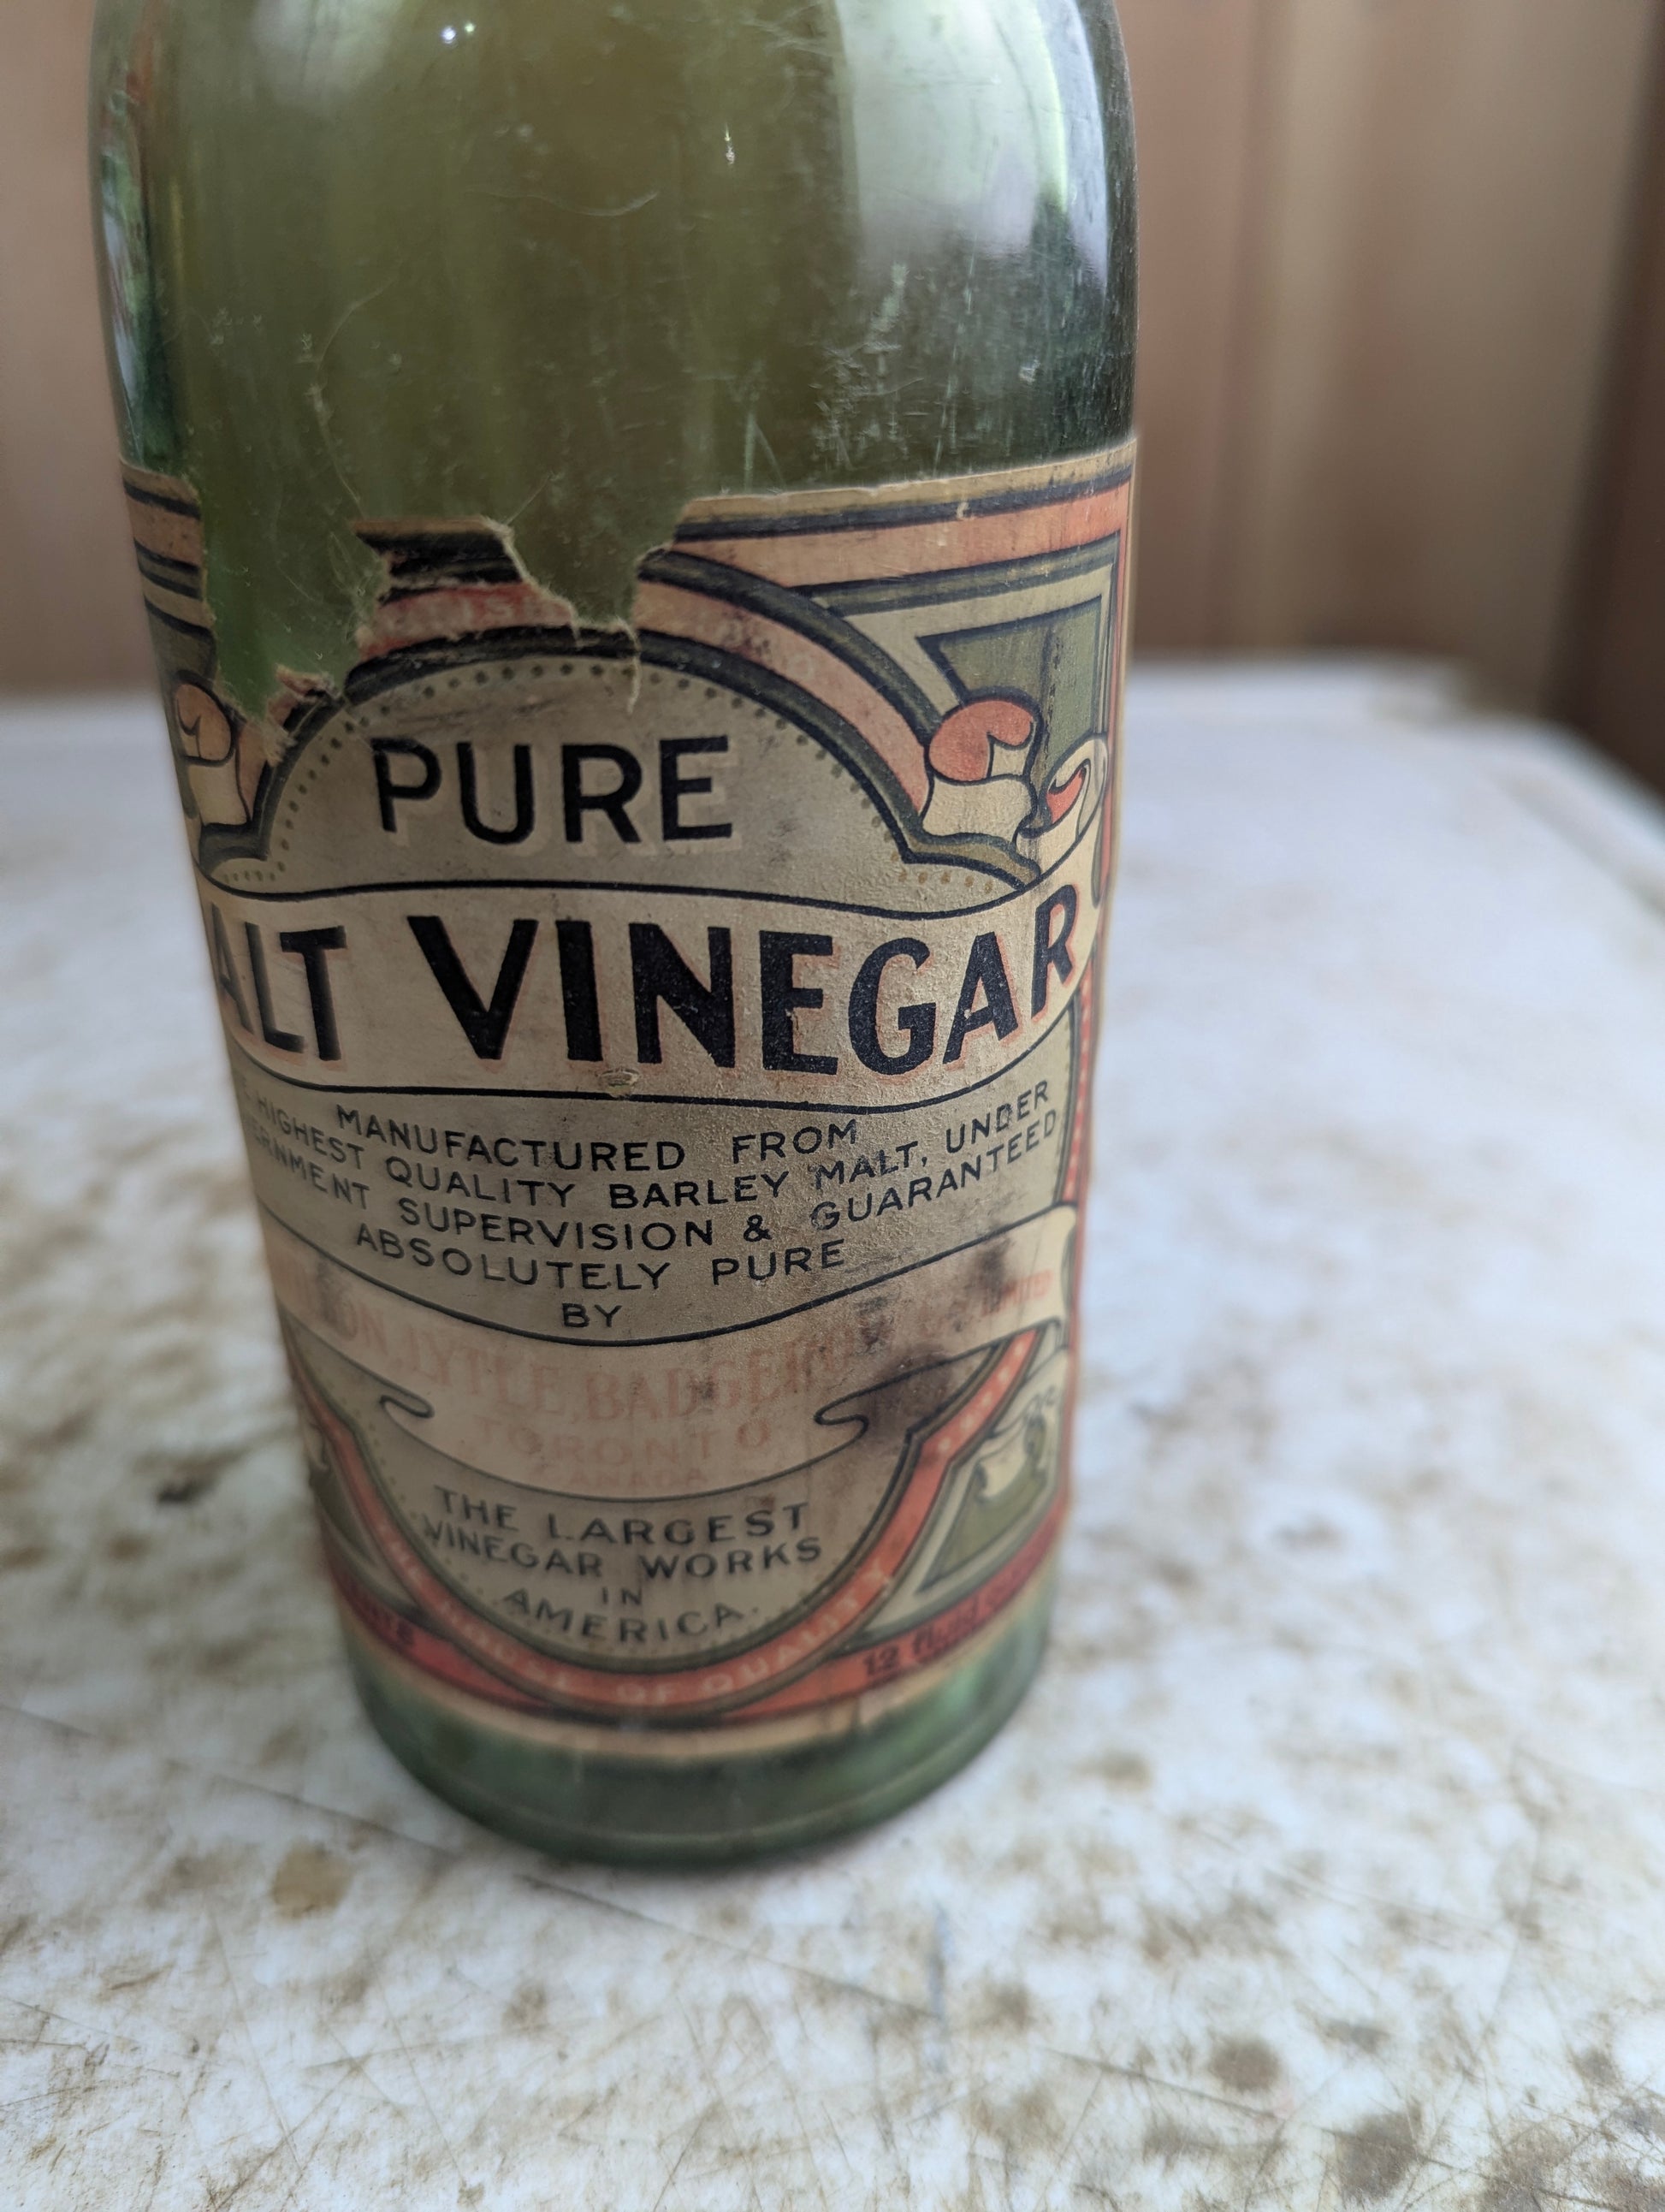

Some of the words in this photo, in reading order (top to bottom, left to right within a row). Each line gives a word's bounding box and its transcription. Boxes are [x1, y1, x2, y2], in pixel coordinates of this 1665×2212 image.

[371, 736, 732, 845] PURE
[407, 884, 1078, 1076] VINEGAR
[257, 1092, 365, 1171] HIGHEST
[386, 1155, 577, 1208] QUALITY
[610, 1171, 790, 1210] BARLEY
[815, 1141, 928, 1190] MALT,
[946, 1080, 1050, 1153] UNDER
[337, 1104, 684, 1171] MANUFACTURED
[732, 1118, 857, 1164] FROM
[400, 1198, 713, 1252] SUPERVISION
[743, 1215, 772, 1242] &
[810, 1110, 1058, 1231] GUARANTEED
[357, 1224, 671, 1290] ABSOLUTELY
[712, 1239, 845, 1285] PURE
[562, 1303, 623, 1328] BY
[422, 1513, 603, 1577] VINEGAR
[640, 1537, 822, 1580] WORKS
[433, 1484, 519, 1531] THE
[546, 1503, 809, 1545] LARGEST
[601, 1587, 643, 1607] IN
